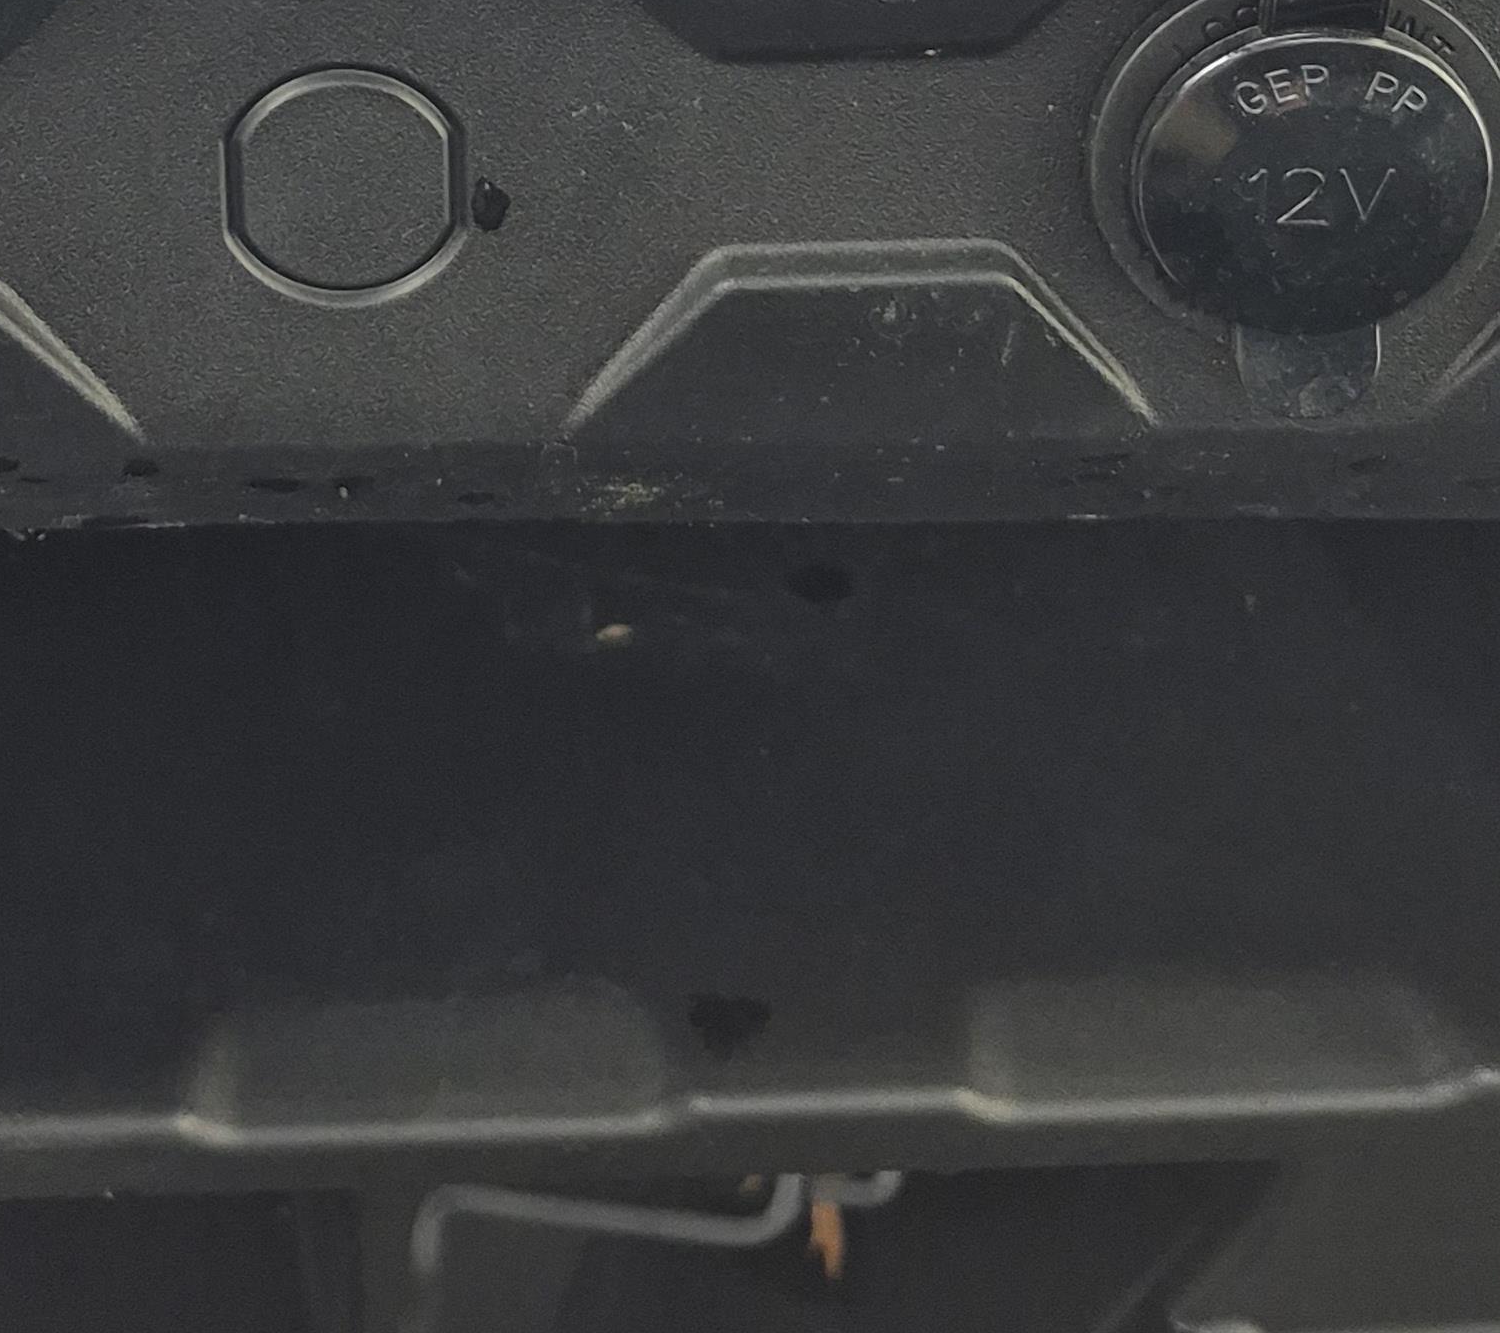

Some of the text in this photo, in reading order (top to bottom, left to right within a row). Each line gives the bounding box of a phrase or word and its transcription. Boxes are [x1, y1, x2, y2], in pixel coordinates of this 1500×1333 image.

[1235, 64, 1428, 115] GEP PP
[1248, 167, 1396, 226] 12V
